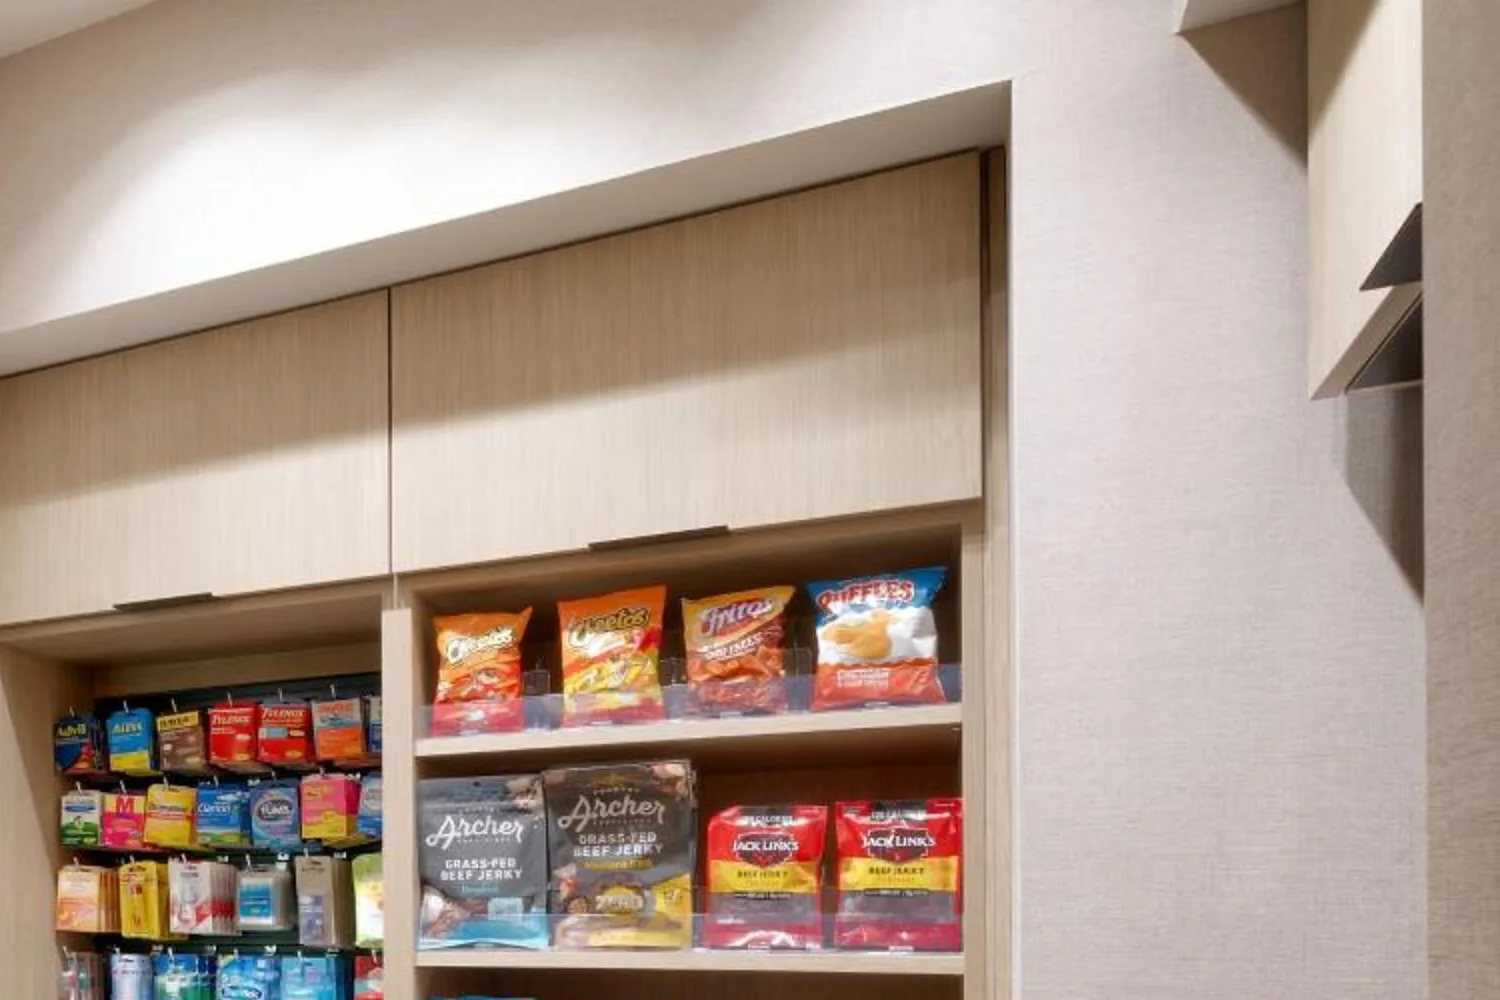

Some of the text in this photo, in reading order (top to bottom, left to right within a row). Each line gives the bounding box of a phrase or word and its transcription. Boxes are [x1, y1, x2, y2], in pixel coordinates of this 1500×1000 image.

[817, 578, 915, 609] RUFFLES
[569, 608, 650, 644] Cheetos
[698, 599, 775, 635] Fritos
[558, 795, 666, 832] Archer
[425, 814, 524, 851] Archer
[580, 832, 657, 845] GRASS-FED
[445, 857, 517, 869] GRASS-FED
[574, 843, 663, 857] BEEF JERKY
[440, 868, 523, 881] BEEF JERKY
